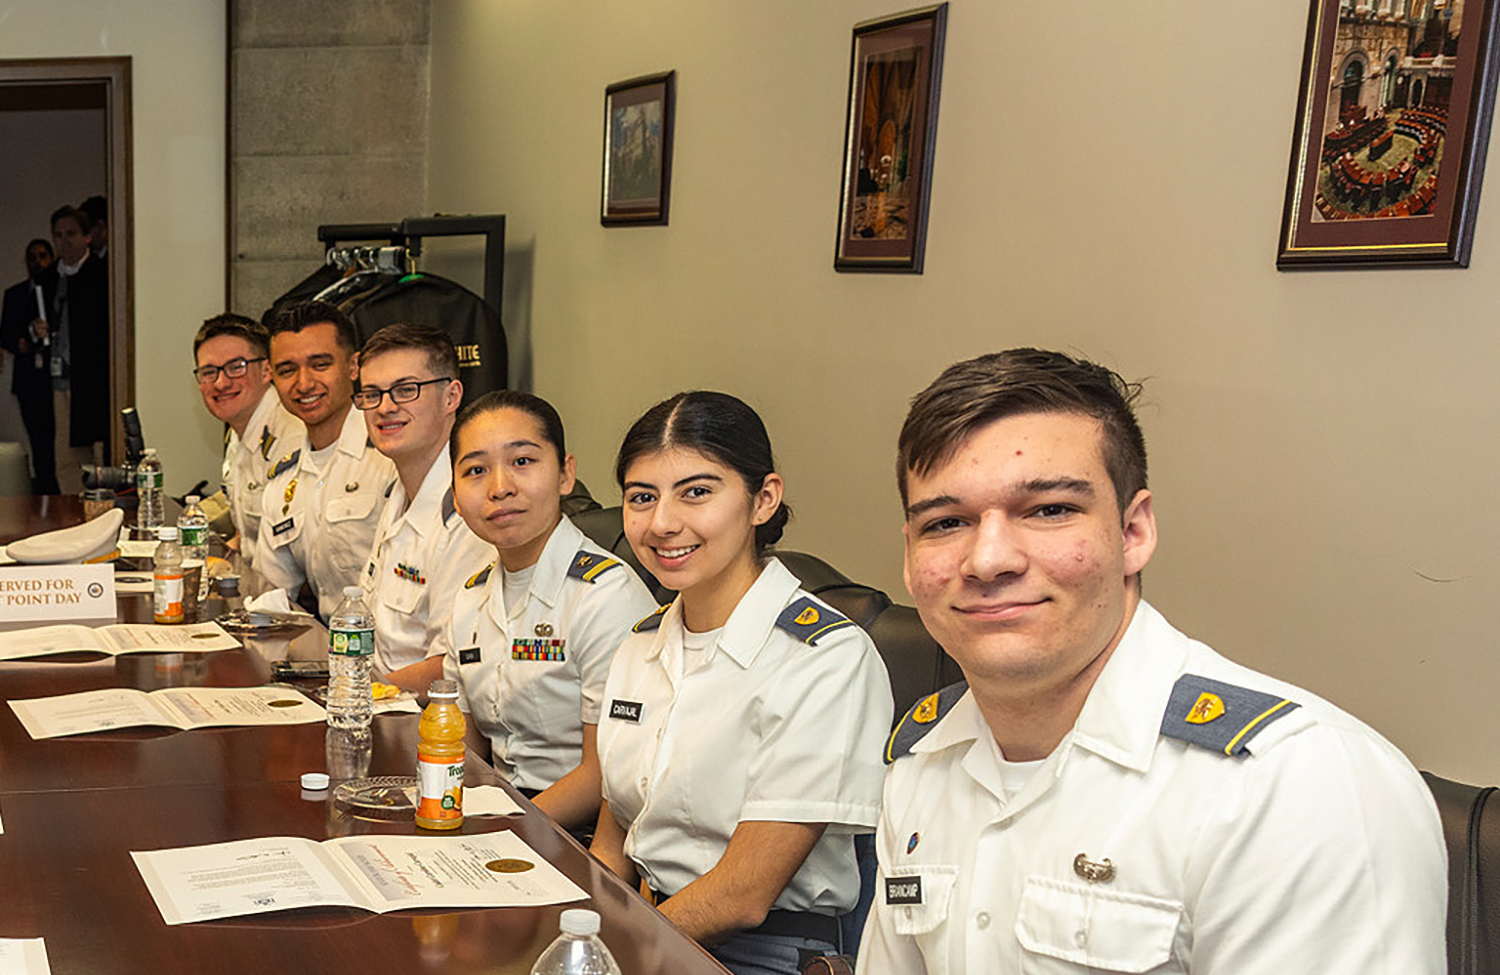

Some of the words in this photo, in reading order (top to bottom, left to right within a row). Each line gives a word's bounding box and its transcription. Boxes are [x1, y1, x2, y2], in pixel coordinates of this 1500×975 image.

[46, 578, 74, 590] FOR
[7, 594, 54, 606] POINT
[56, 592, 83, 604] DAY
